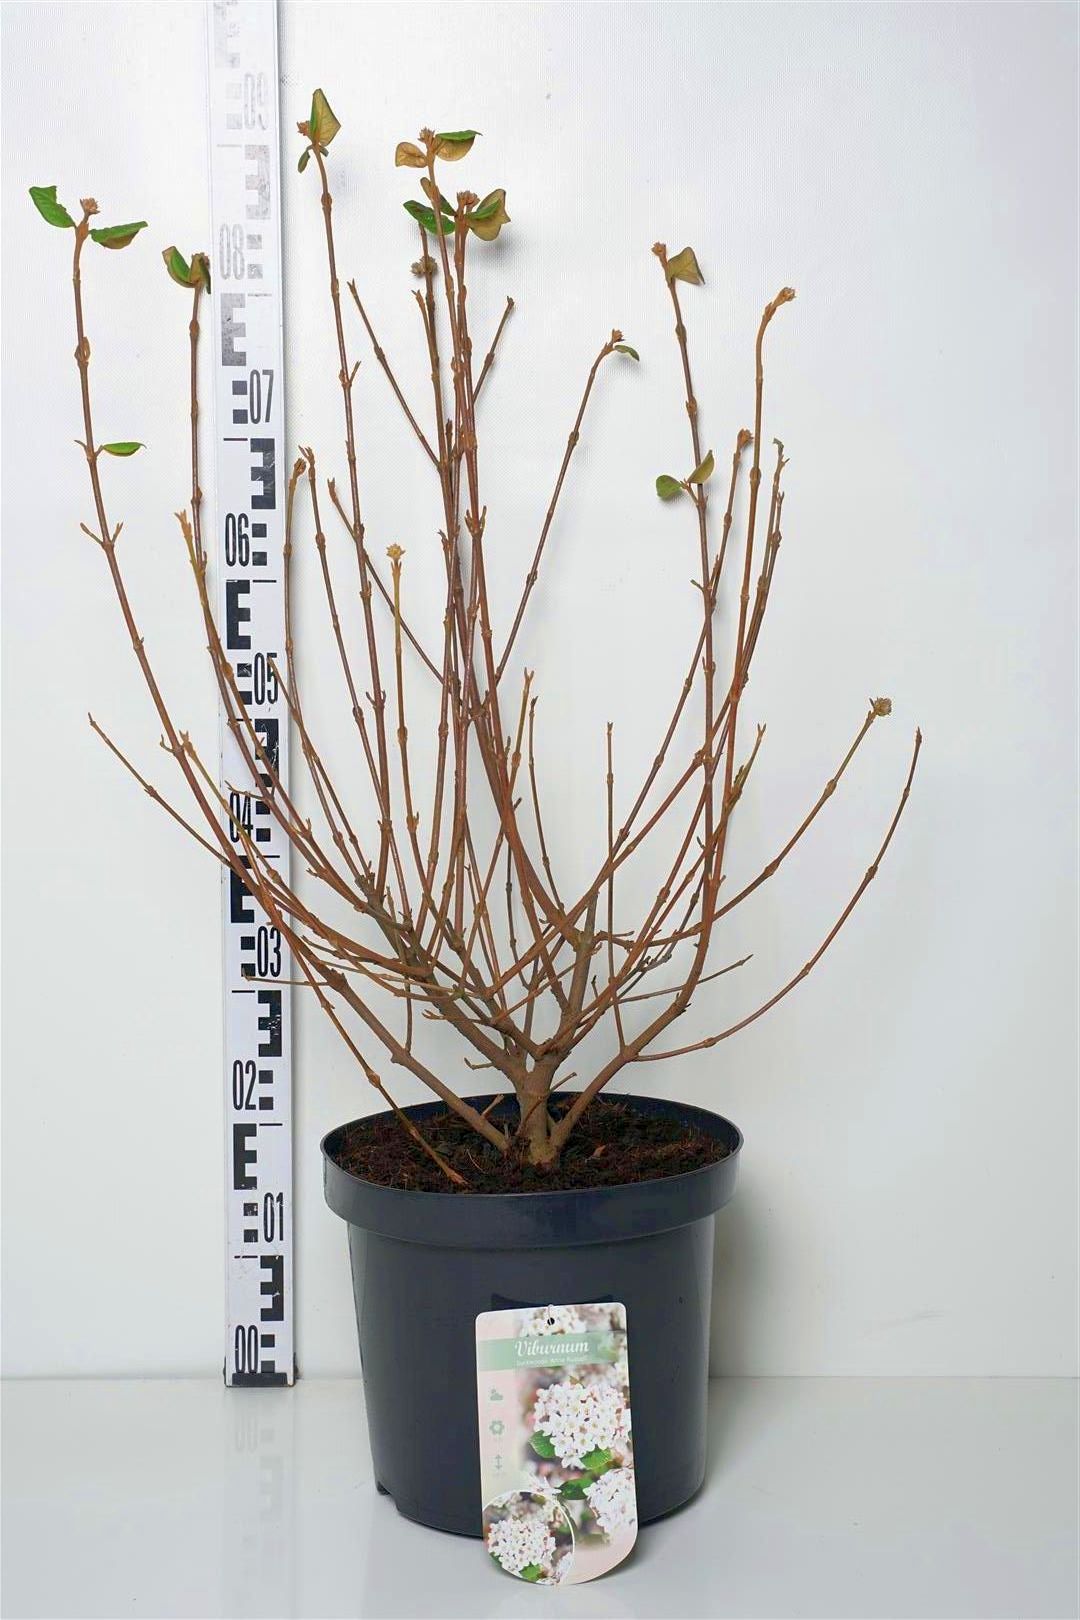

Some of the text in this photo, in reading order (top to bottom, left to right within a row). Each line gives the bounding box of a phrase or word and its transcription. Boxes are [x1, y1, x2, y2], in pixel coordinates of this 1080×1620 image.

[219, 223, 245, 281] 08
[250, 369, 274, 424] 07
[225, 513, 250, 567] 06
[254, 652, 278, 706] 05
[229, 791, 253, 843] 04
[257, 926, 281, 978] 03
[232, 1060, 257, 1111] 02
[263, 1192, 284, 1243] 01
[234, 1324, 258, 1374] 00
[514, 1340, 590, 1357] Viburnum
